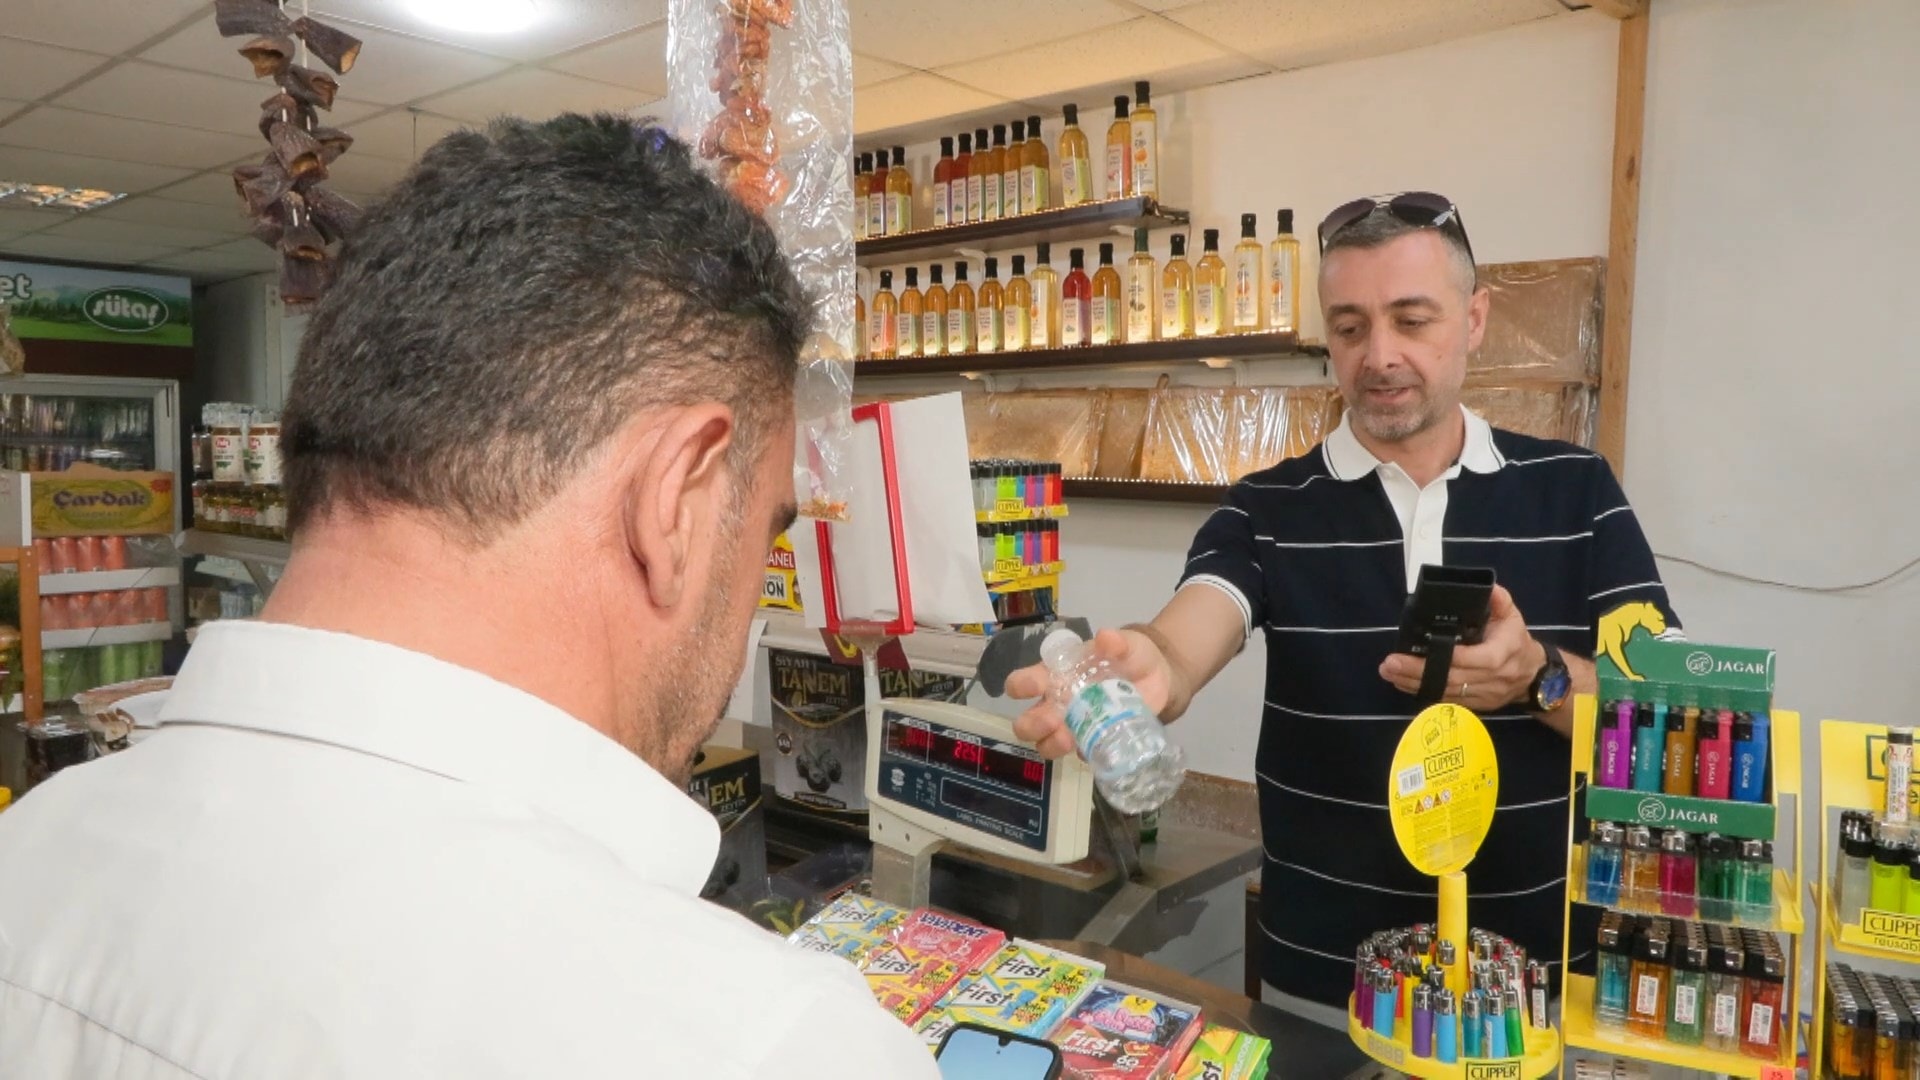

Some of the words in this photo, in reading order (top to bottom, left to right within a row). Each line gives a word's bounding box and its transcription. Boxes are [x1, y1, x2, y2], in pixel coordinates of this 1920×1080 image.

[767, 551, 795, 568] ANEL
[1714, 660, 1765, 674] JAGAR
[881, 667, 951, 698] TANE
[1427, 752, 1461, 774] CLIPPER
[1667, 808, 1719, 825] JAGAR
[996, 957, 1051, 979] First
[960, 981, 1014, 1006] First
[1063, 1030, 1121, 1053] First
[1470, 1065, 1517, 1078] CLIPPER
